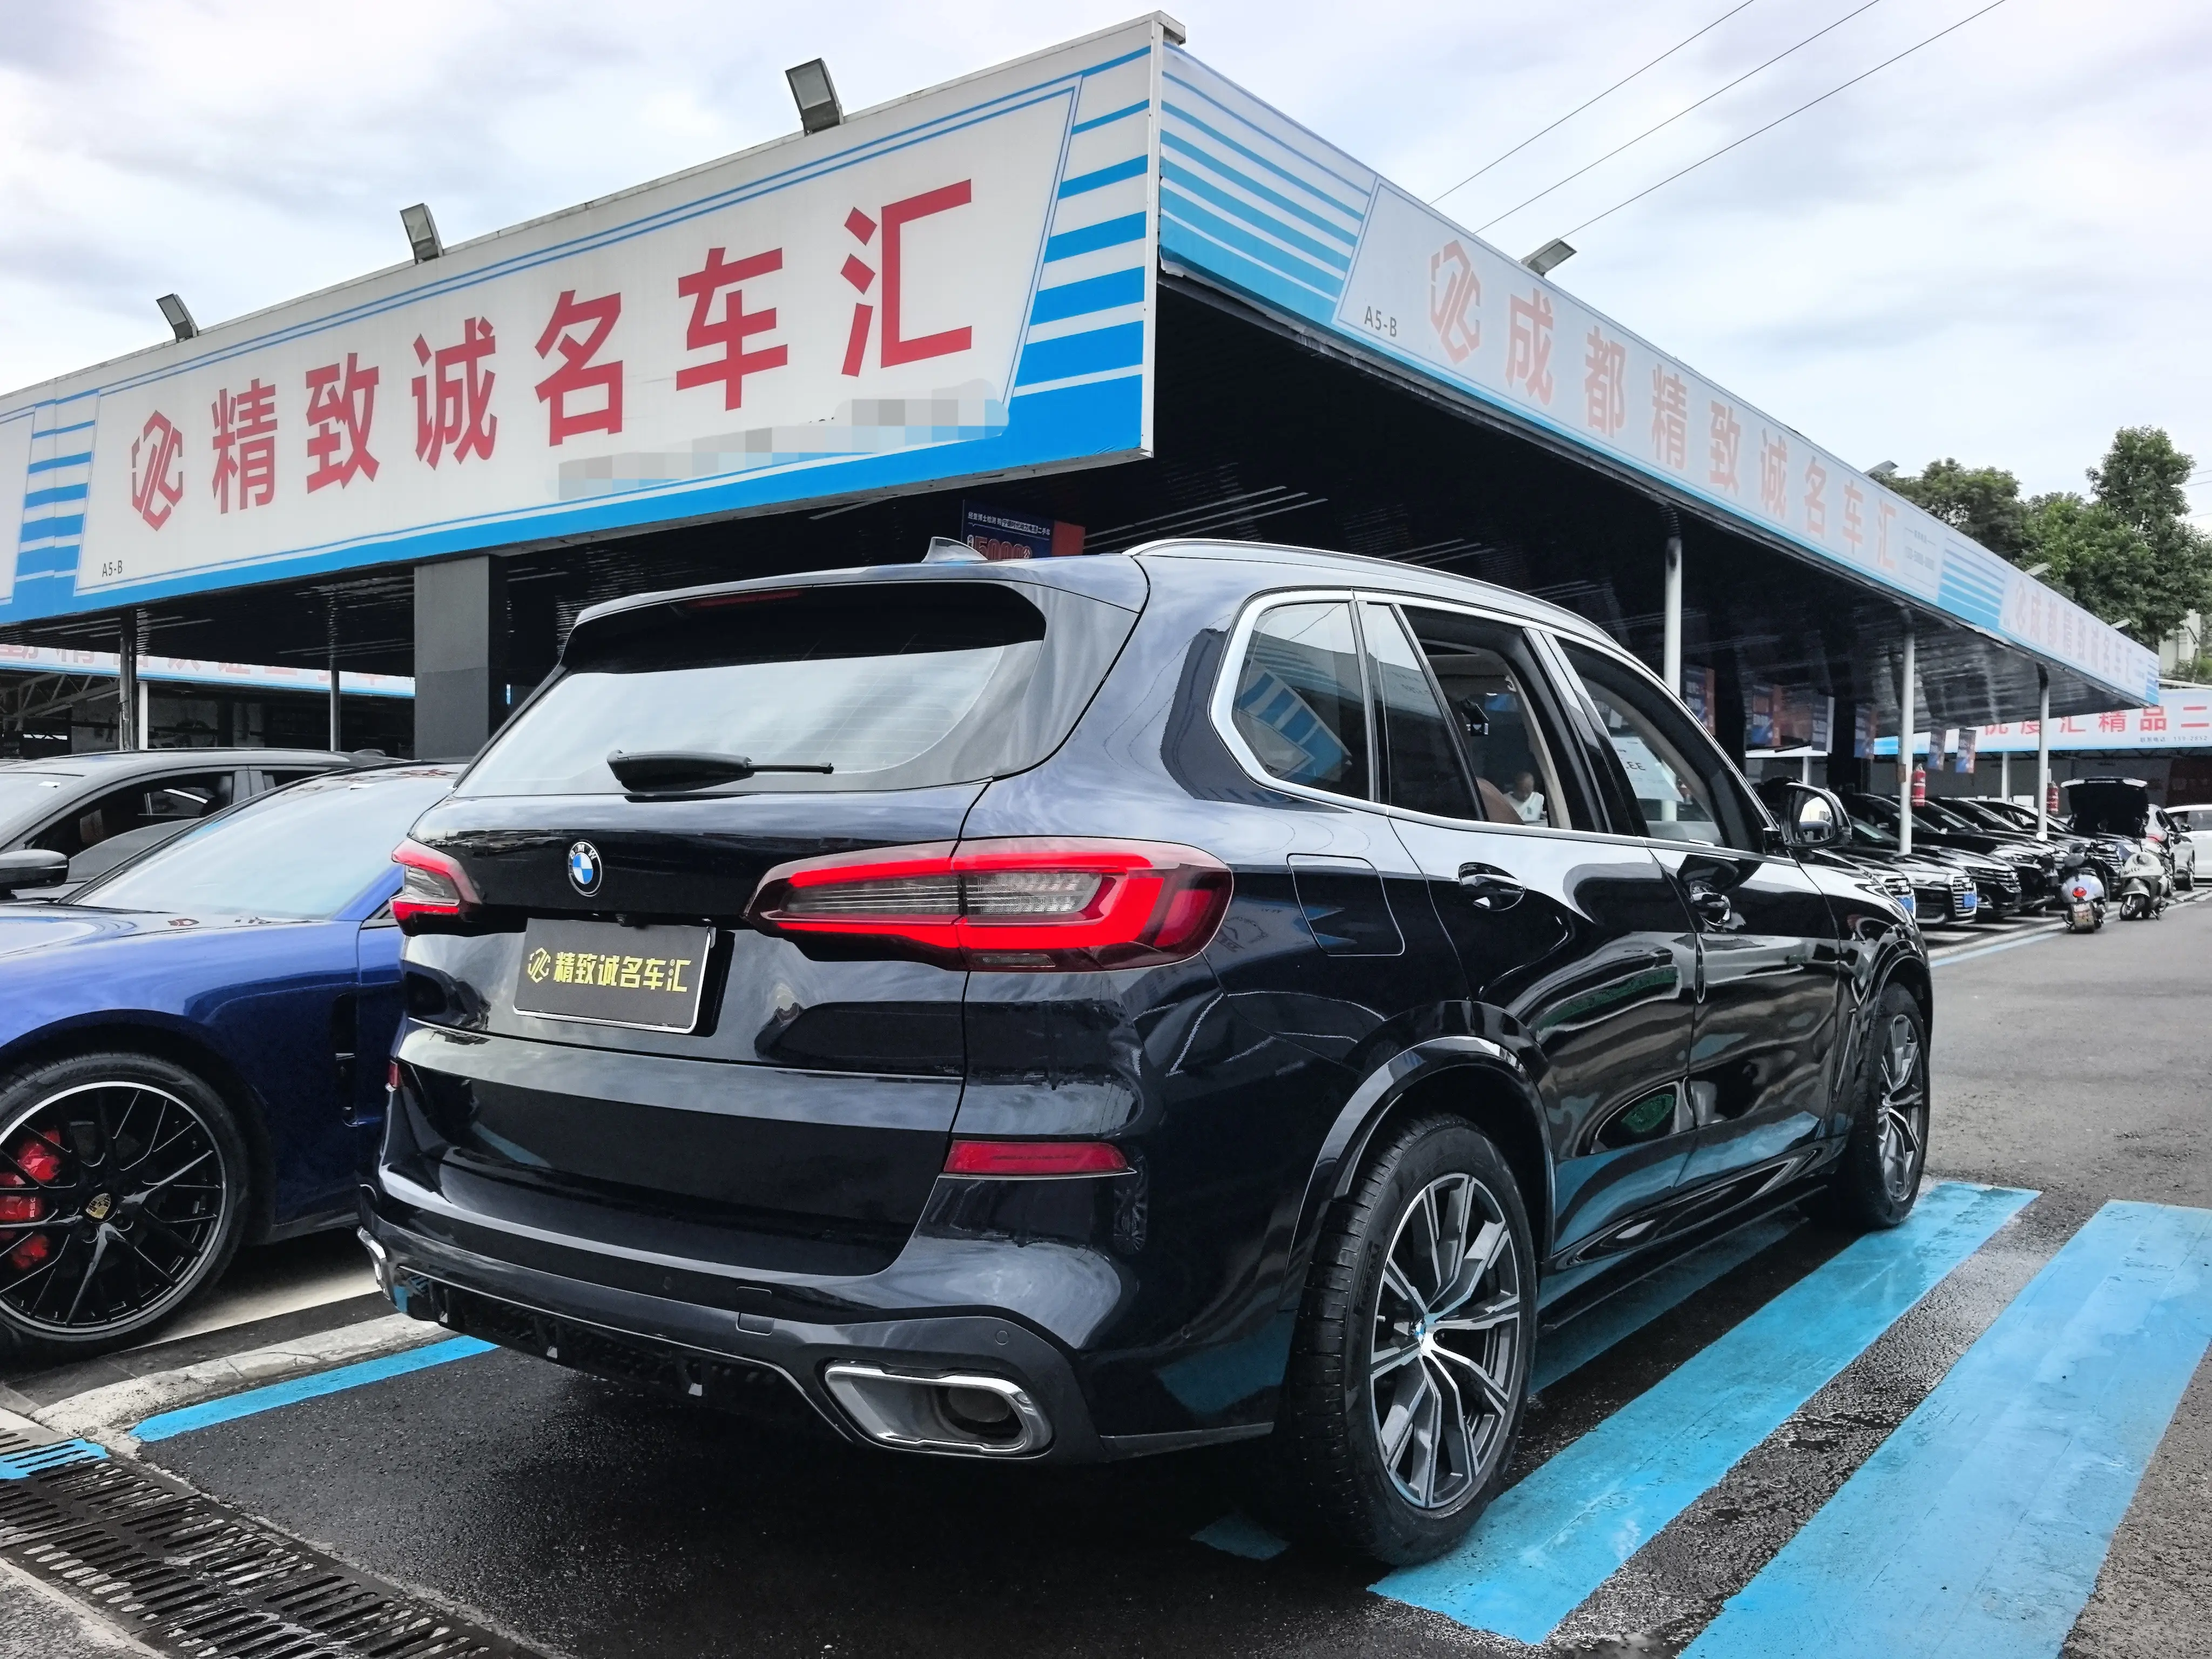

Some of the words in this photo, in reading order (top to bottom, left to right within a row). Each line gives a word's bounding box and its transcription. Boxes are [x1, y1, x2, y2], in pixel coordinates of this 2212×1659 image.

[1364, 306, 1398, 337] A5-B
[212, 179, 972, 514] 精致诚名车汇
[1505, 288, 1896, 570] 成都精致诚名车汇
[102, 560, 123, 577] A5-B
[569, 844, 598, 860] BMW
[554, 951, 692, 992] 精致诚名车汇
